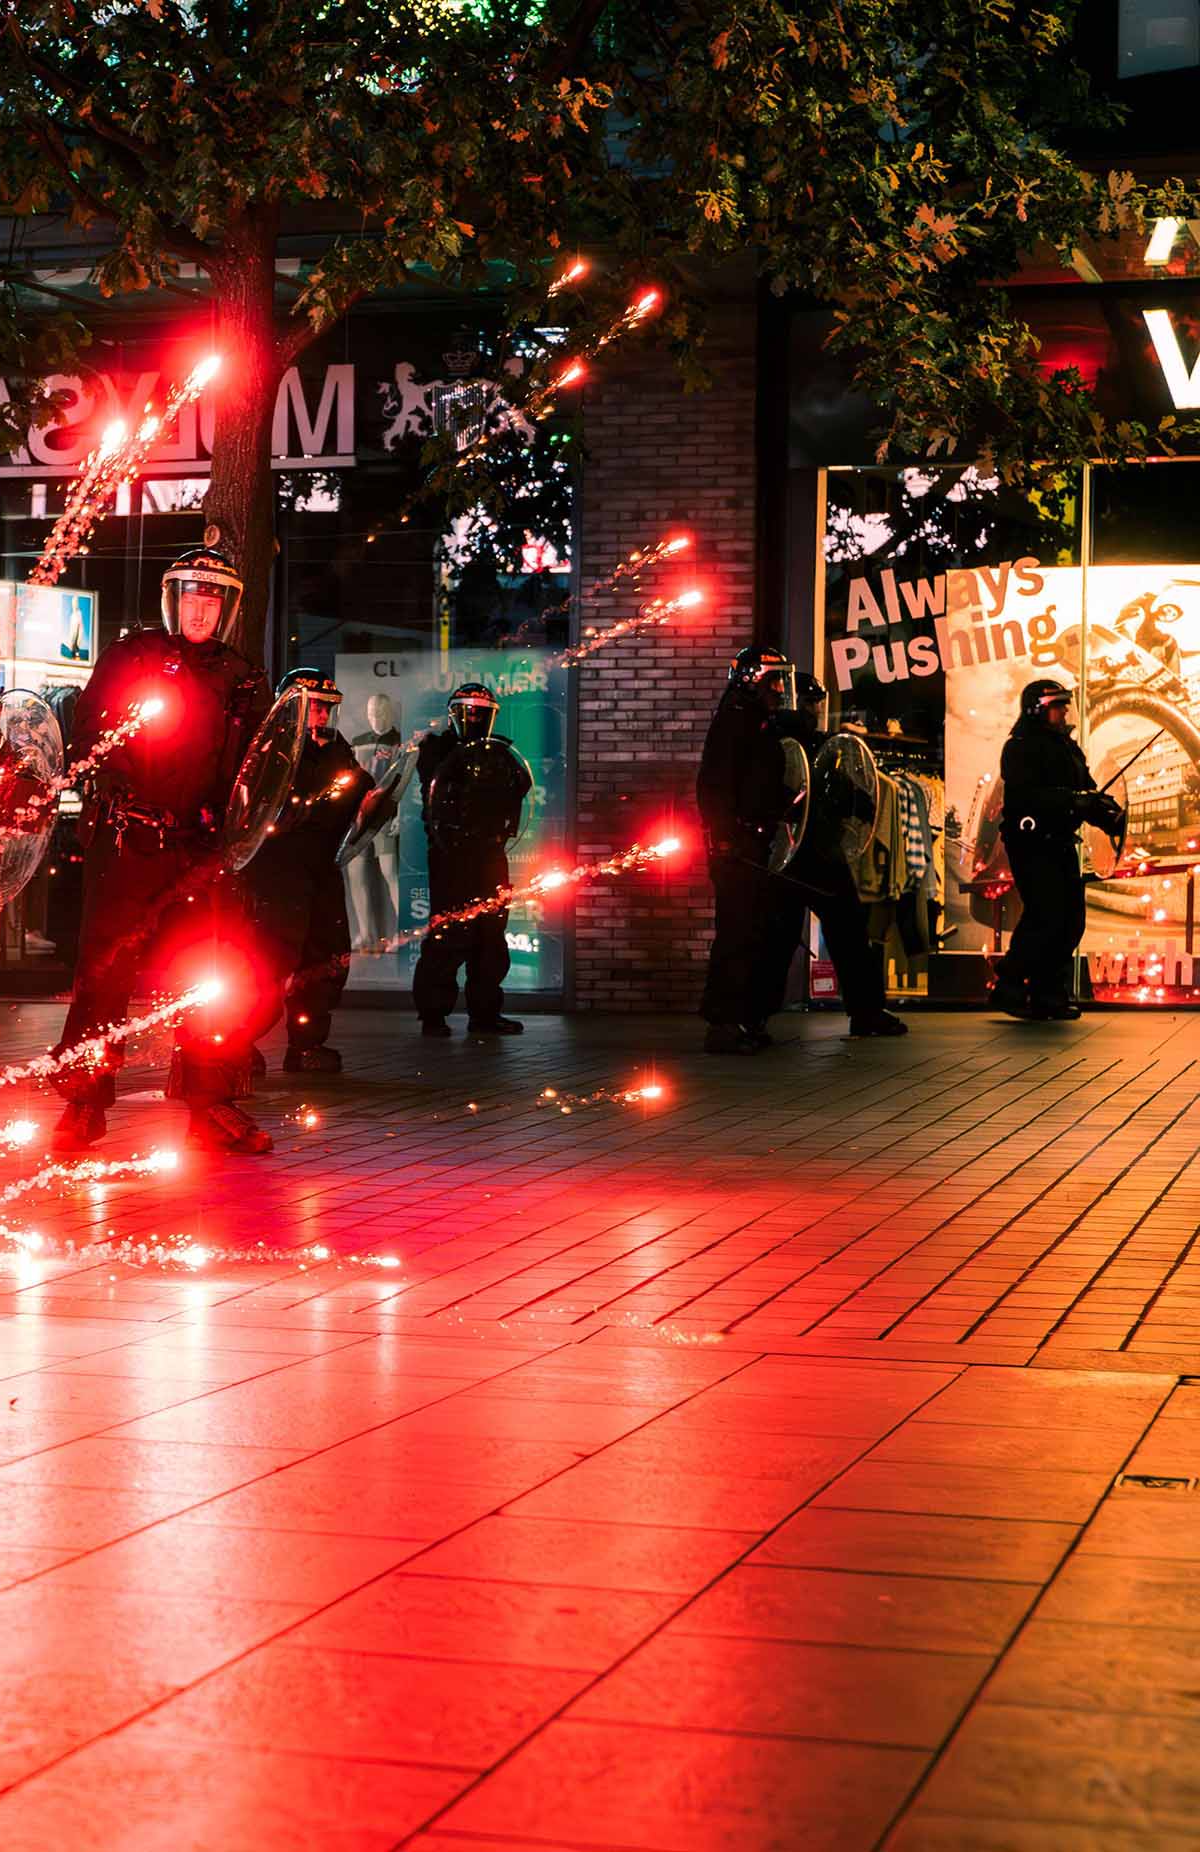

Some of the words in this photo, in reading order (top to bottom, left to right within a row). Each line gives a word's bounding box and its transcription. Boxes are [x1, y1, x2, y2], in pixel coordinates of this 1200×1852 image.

[191, 571, 219, 582] POLICE
[846, 556, 1045, 632] Always
[830, 604, 1067, 692] Pushing
[1087, 939, 1193, 986] with
